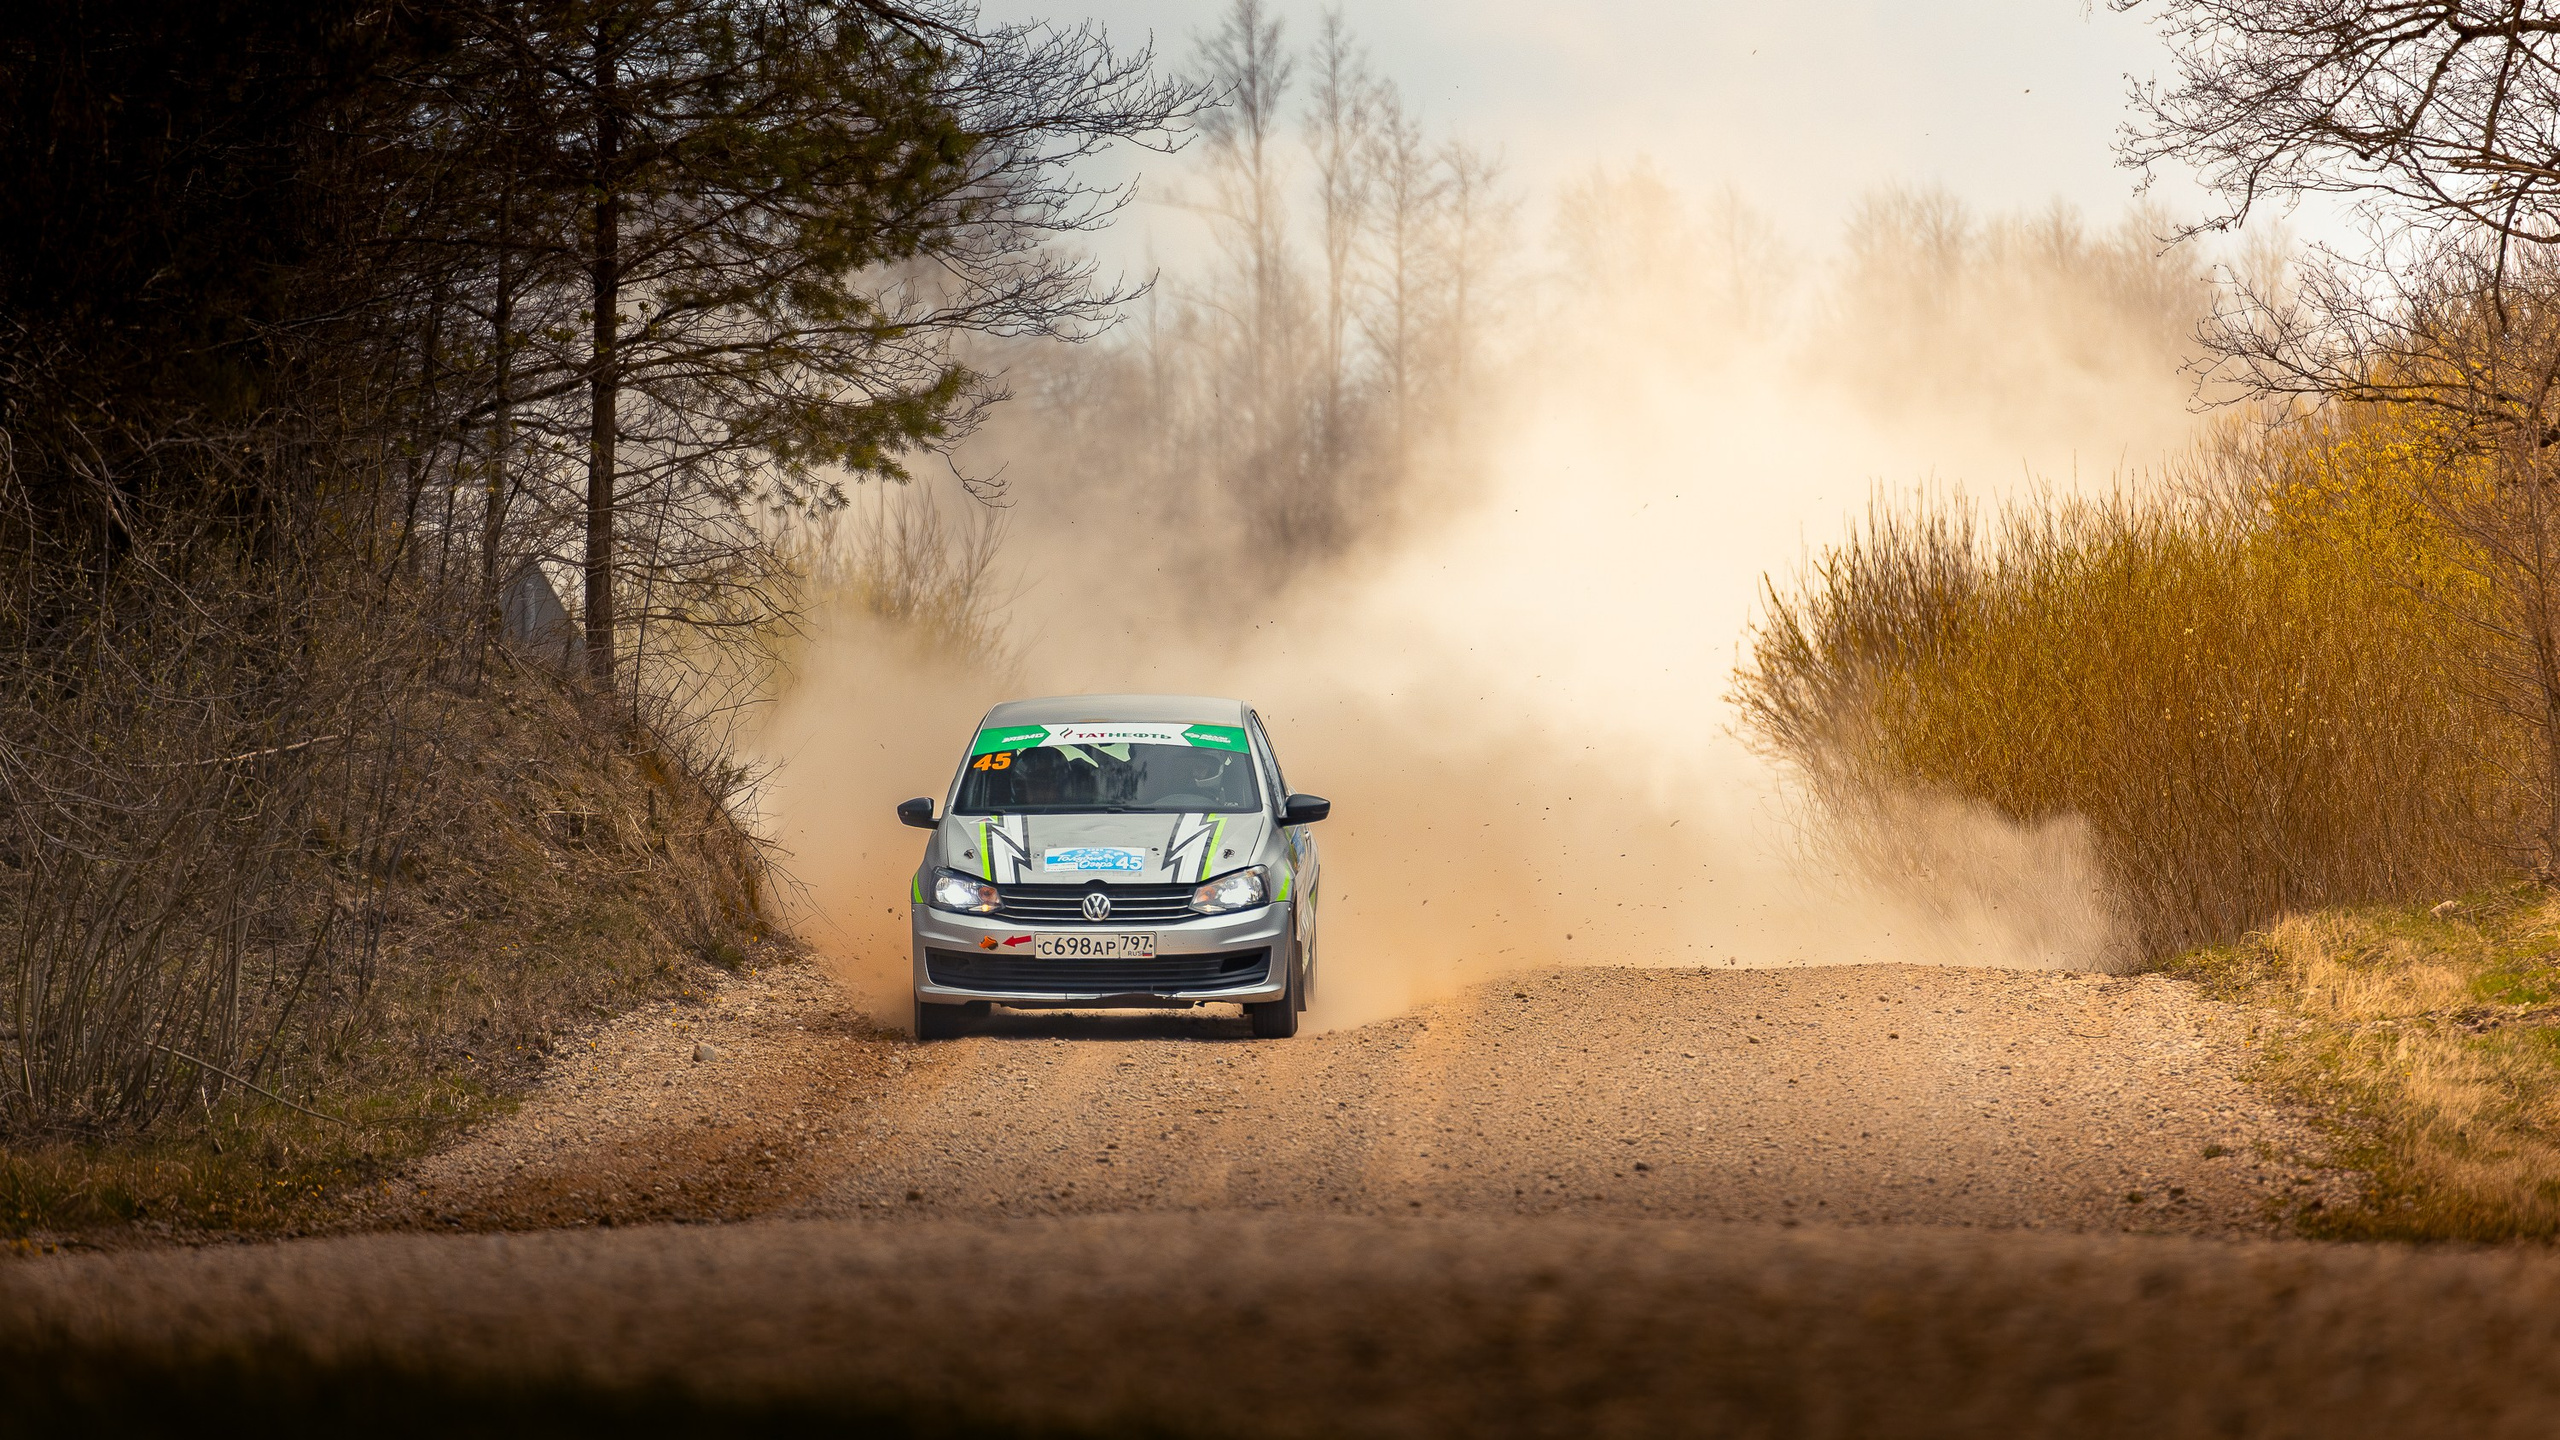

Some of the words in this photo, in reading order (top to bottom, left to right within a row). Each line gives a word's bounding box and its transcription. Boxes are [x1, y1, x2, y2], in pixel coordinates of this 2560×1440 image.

[1076, 732, 1172, 740] ТАТНЕФТЬ
[973, 752, 1012, 771] 45
[1116, 856, 1142, 870] 45
[1042, 937, 1116, 955] С698АР
[1120, 936, 1149, 950] 797
